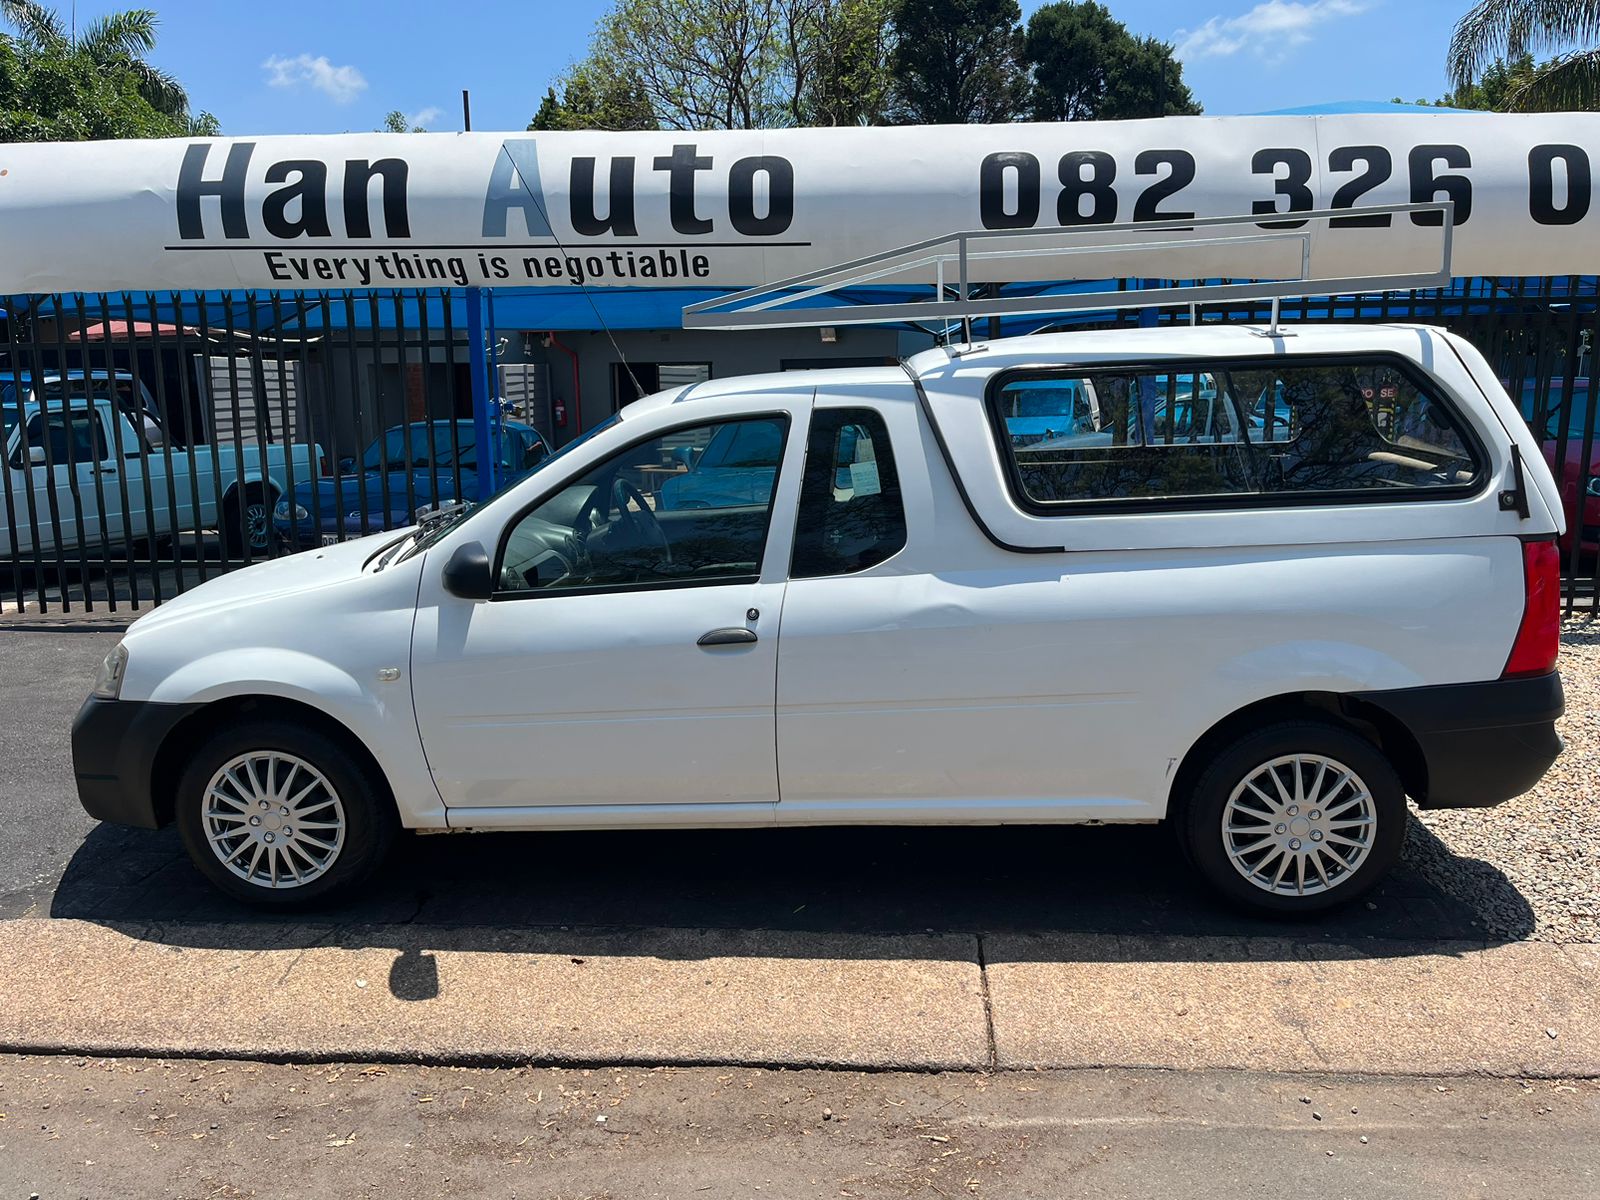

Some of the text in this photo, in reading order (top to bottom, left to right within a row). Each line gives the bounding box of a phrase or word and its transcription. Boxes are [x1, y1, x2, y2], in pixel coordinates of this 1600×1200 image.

[176, 138, 794, 240] Han Auto
[979, 144, 1592, 231] 082 326 0
[263, 249, 710, 286] Everything is negotiable
